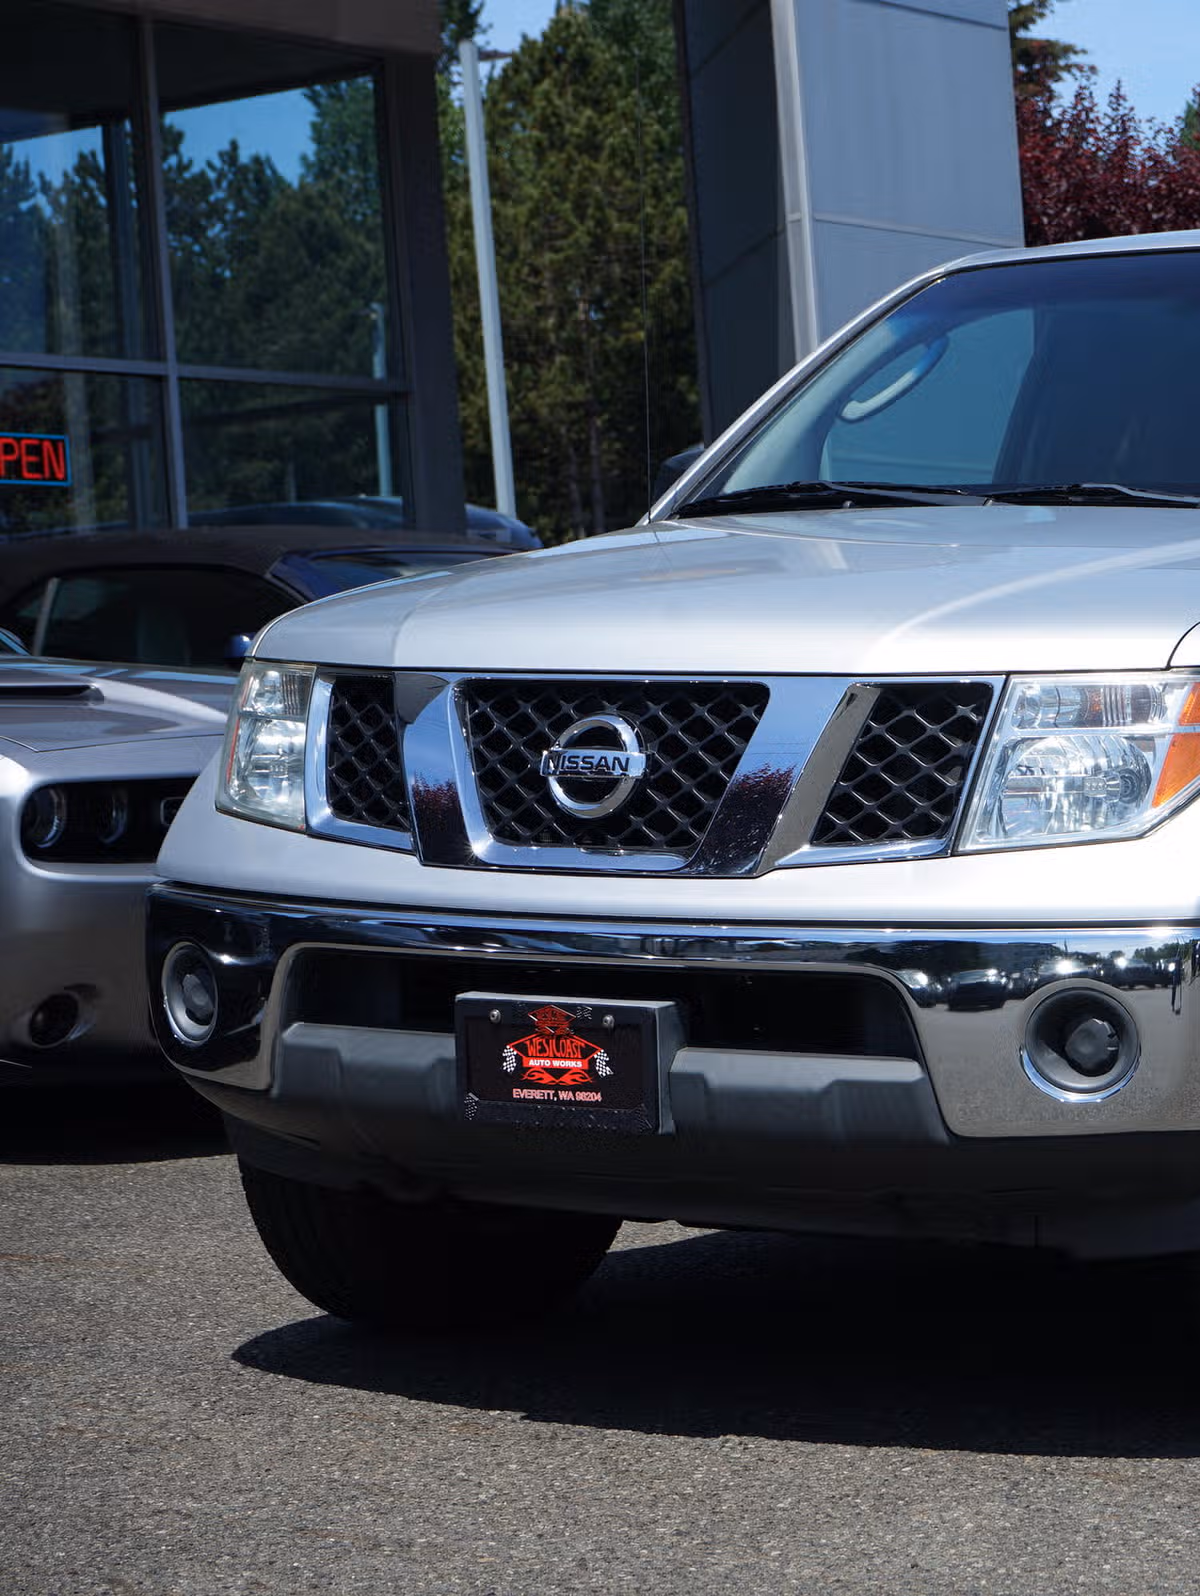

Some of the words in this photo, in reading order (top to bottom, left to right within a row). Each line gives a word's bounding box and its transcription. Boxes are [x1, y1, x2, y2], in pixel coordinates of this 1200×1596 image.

[0, 437, 65, 480] PEN
[547, 755, 630, 773] NISSAN
[528, 1059, 551, 1067] AUTO
[552, 1060, 582, 1068] WORKS
[512, 1088, 557, 1101] EVERETT,
[558, 1090, 575, 1101] WA
